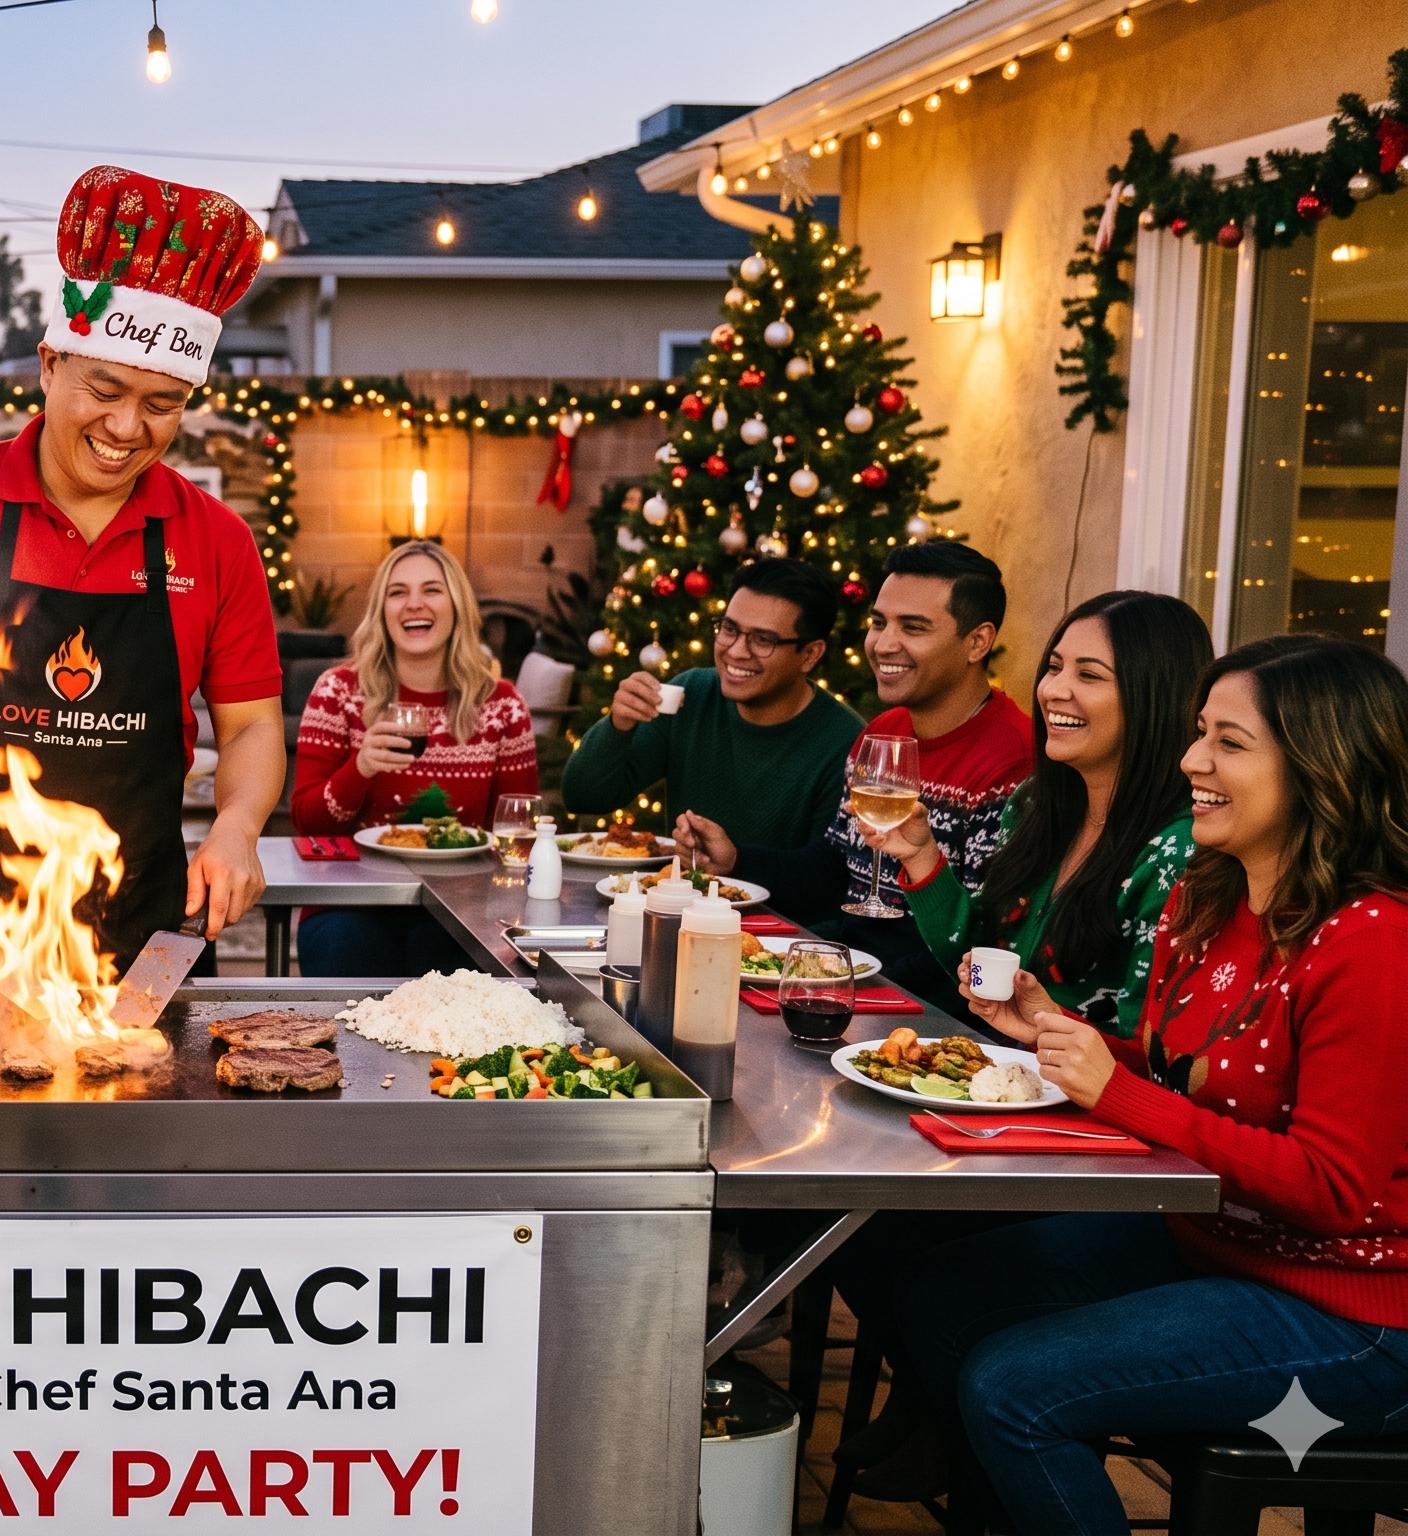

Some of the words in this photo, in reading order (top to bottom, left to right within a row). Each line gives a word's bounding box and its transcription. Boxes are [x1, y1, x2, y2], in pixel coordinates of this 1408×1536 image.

[104, 312, 166, 355] Chef
[169, 326, 203, 361] Ben
[33, 730, 74, 746] Santa
[56, 710, 147, 731] HIBACHI
[13, 1266, 487, 1346] HIBACHI
[112, 1371, 270, 1412] Santa
[285, 1372, 397, 1412] Ana
[111, 1448, 461, 1517] PARTY!
